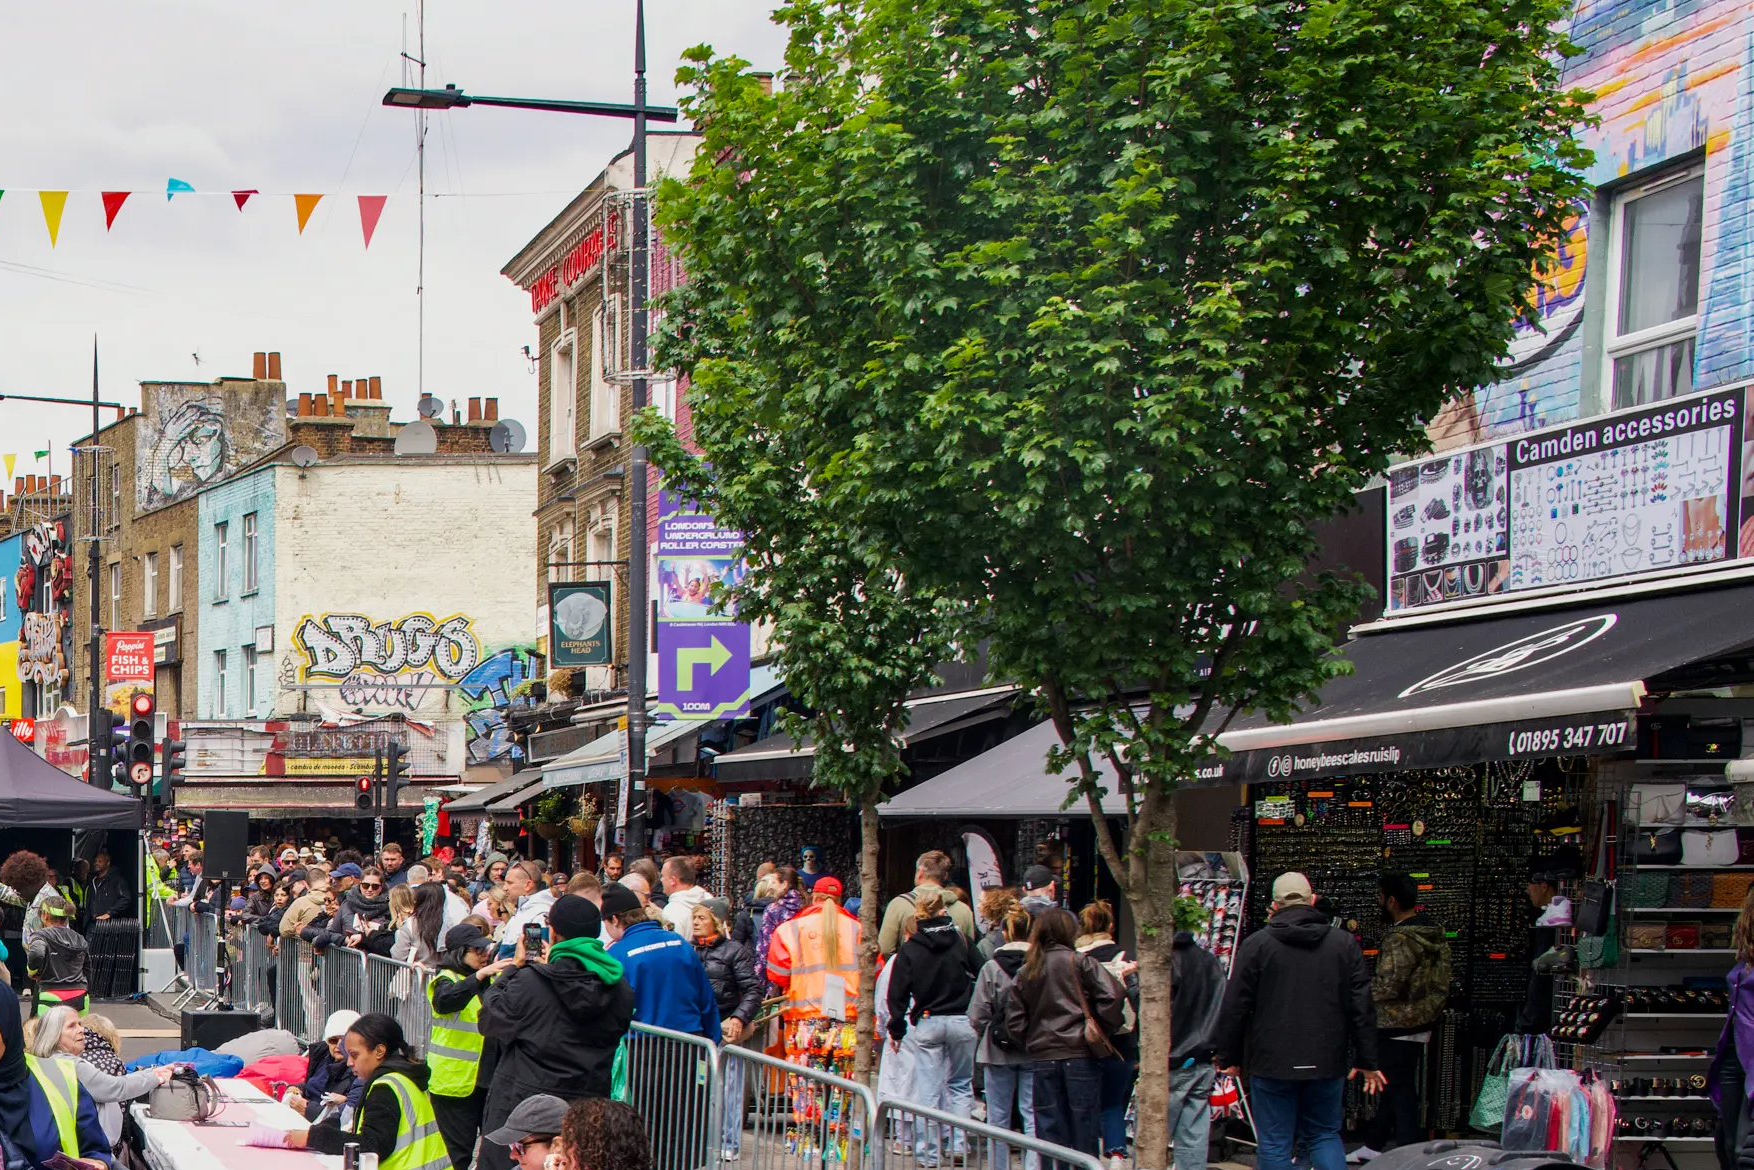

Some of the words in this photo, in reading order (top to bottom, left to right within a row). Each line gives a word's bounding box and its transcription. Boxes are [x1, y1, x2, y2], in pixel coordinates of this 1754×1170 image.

[1516, 429, 1597, 465] Camden
[1601, 396, 1737, 446] accessories
[664, 522, 715, 531] LONDON'S
[660, 542, 699, 550] ROLLER
[115, 640, 145, 654] Poppies
[560, 639, 601, 648] ELEPHANTS
[570, 646, 592, 654] HEAD
[111, 655, 139, 665] FISH
[141, 656, 149, 665] &
[111, 665, 149, 675] CHIPS
[682, 702, 711, 711] 100M
[13, 720, 33, 738] illy
[1515, 729, 1560, 754] 01895
[1562, 726, 1594, 750] 347
[1596, 721, 1628, 747] 707
[1293, 746, 1401, 772] honeybeescakesruislip
